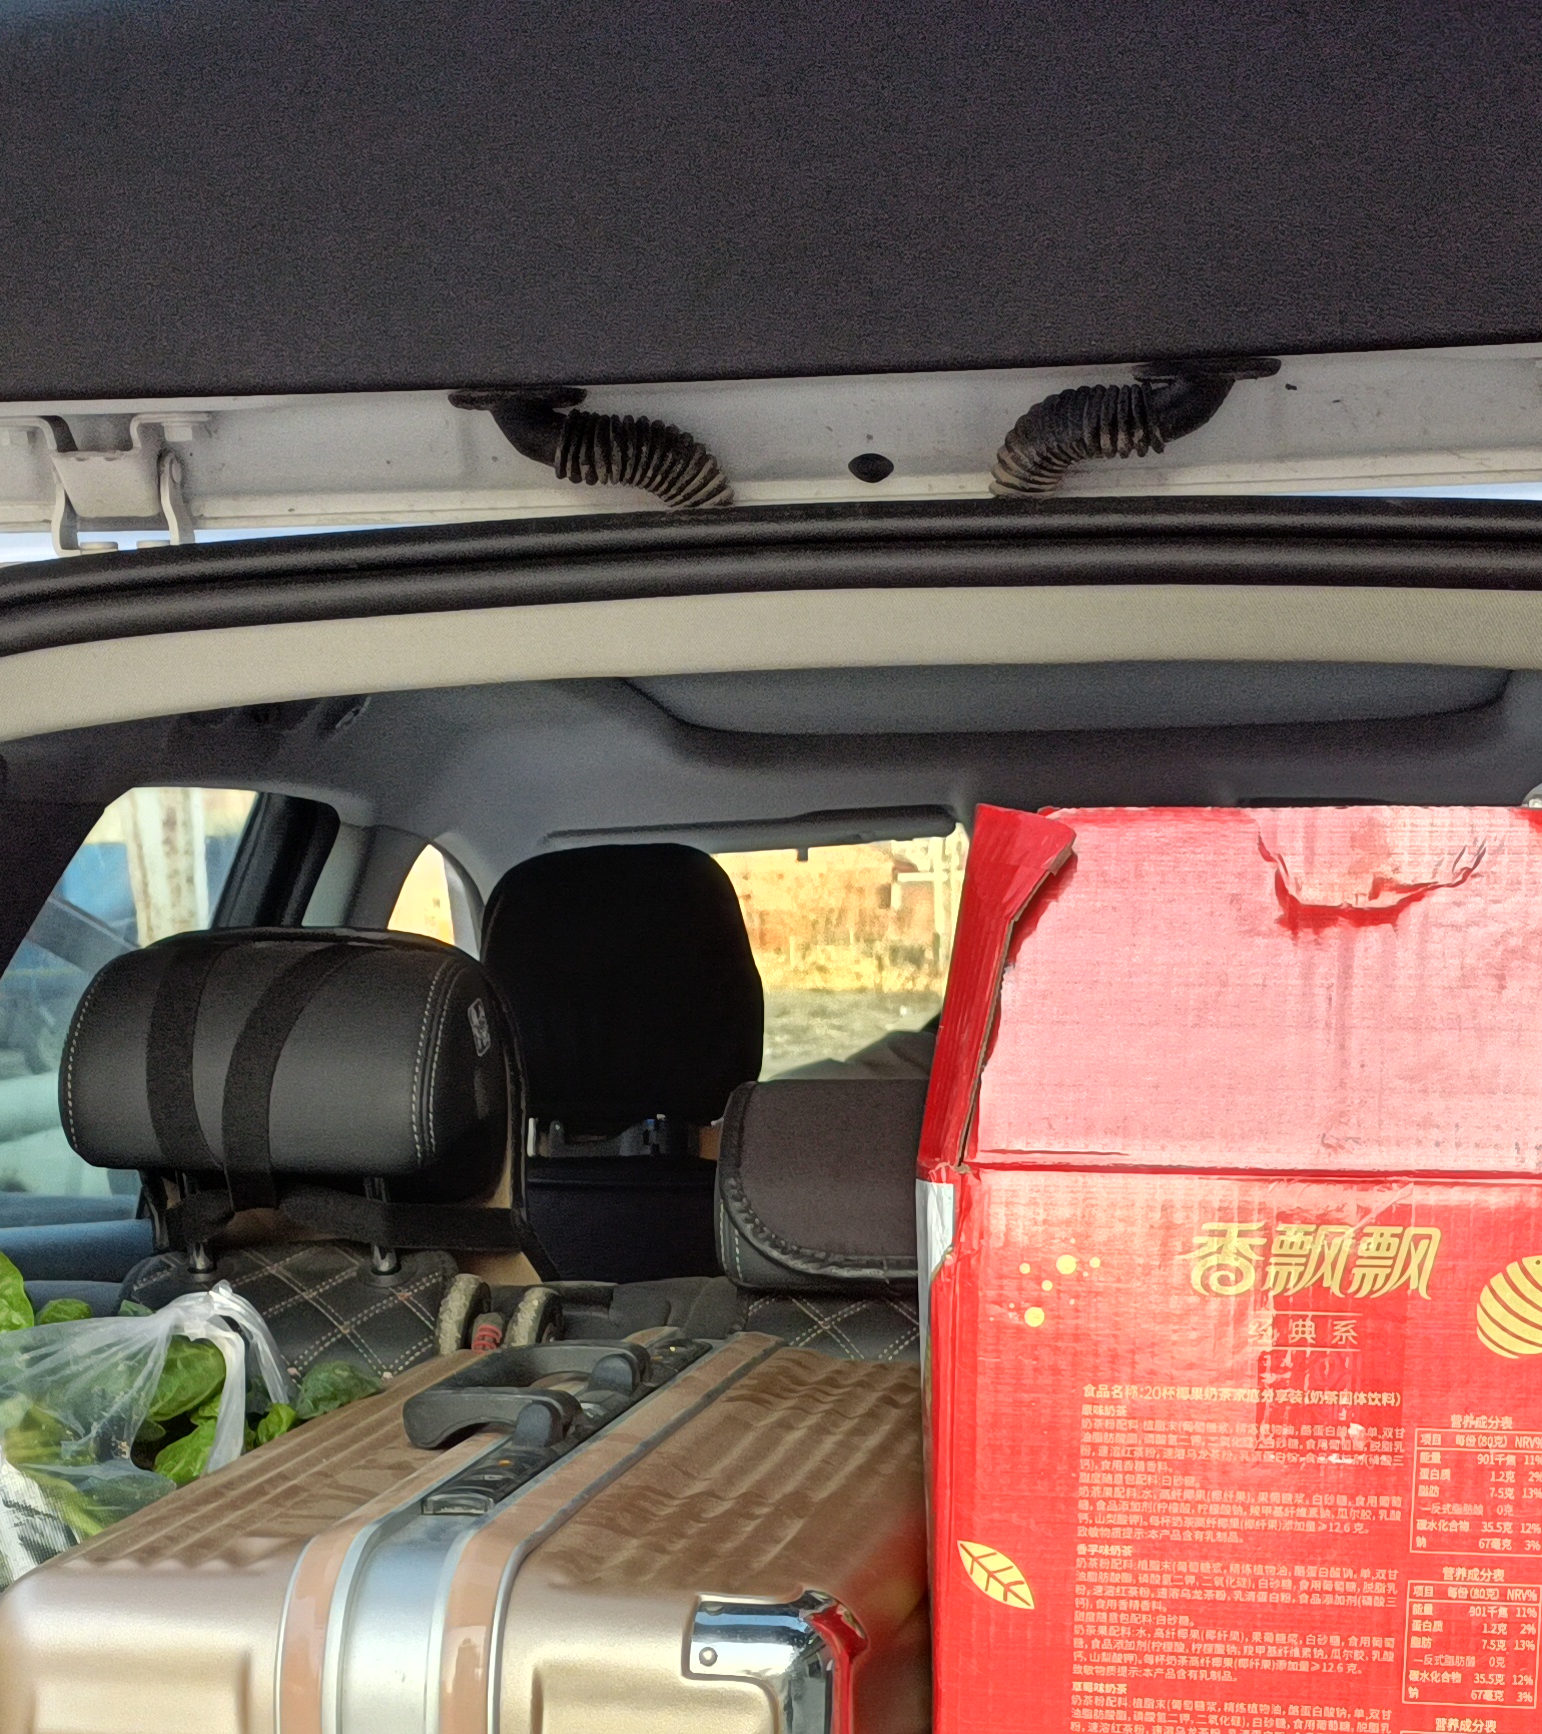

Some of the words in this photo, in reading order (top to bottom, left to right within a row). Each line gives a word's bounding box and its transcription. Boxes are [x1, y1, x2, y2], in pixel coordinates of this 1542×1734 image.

[1175, 1221, 1442, 1300] 香飘飘
[1522, 1486, 1542, 1498] 13%
[1519, 1522, 1541, 1534] 12%
[1523, 1540, 1540, 1551] 3%
[1515, 1608, 1537, 1620] 11%
[1519, 1623, 1536, 1635] 2%
[1513, 1639, 1535, 1651] 13%
[1511, 1674, 1533, 1686] 12%
[1515, 1692, 1532, 1703] 3%
